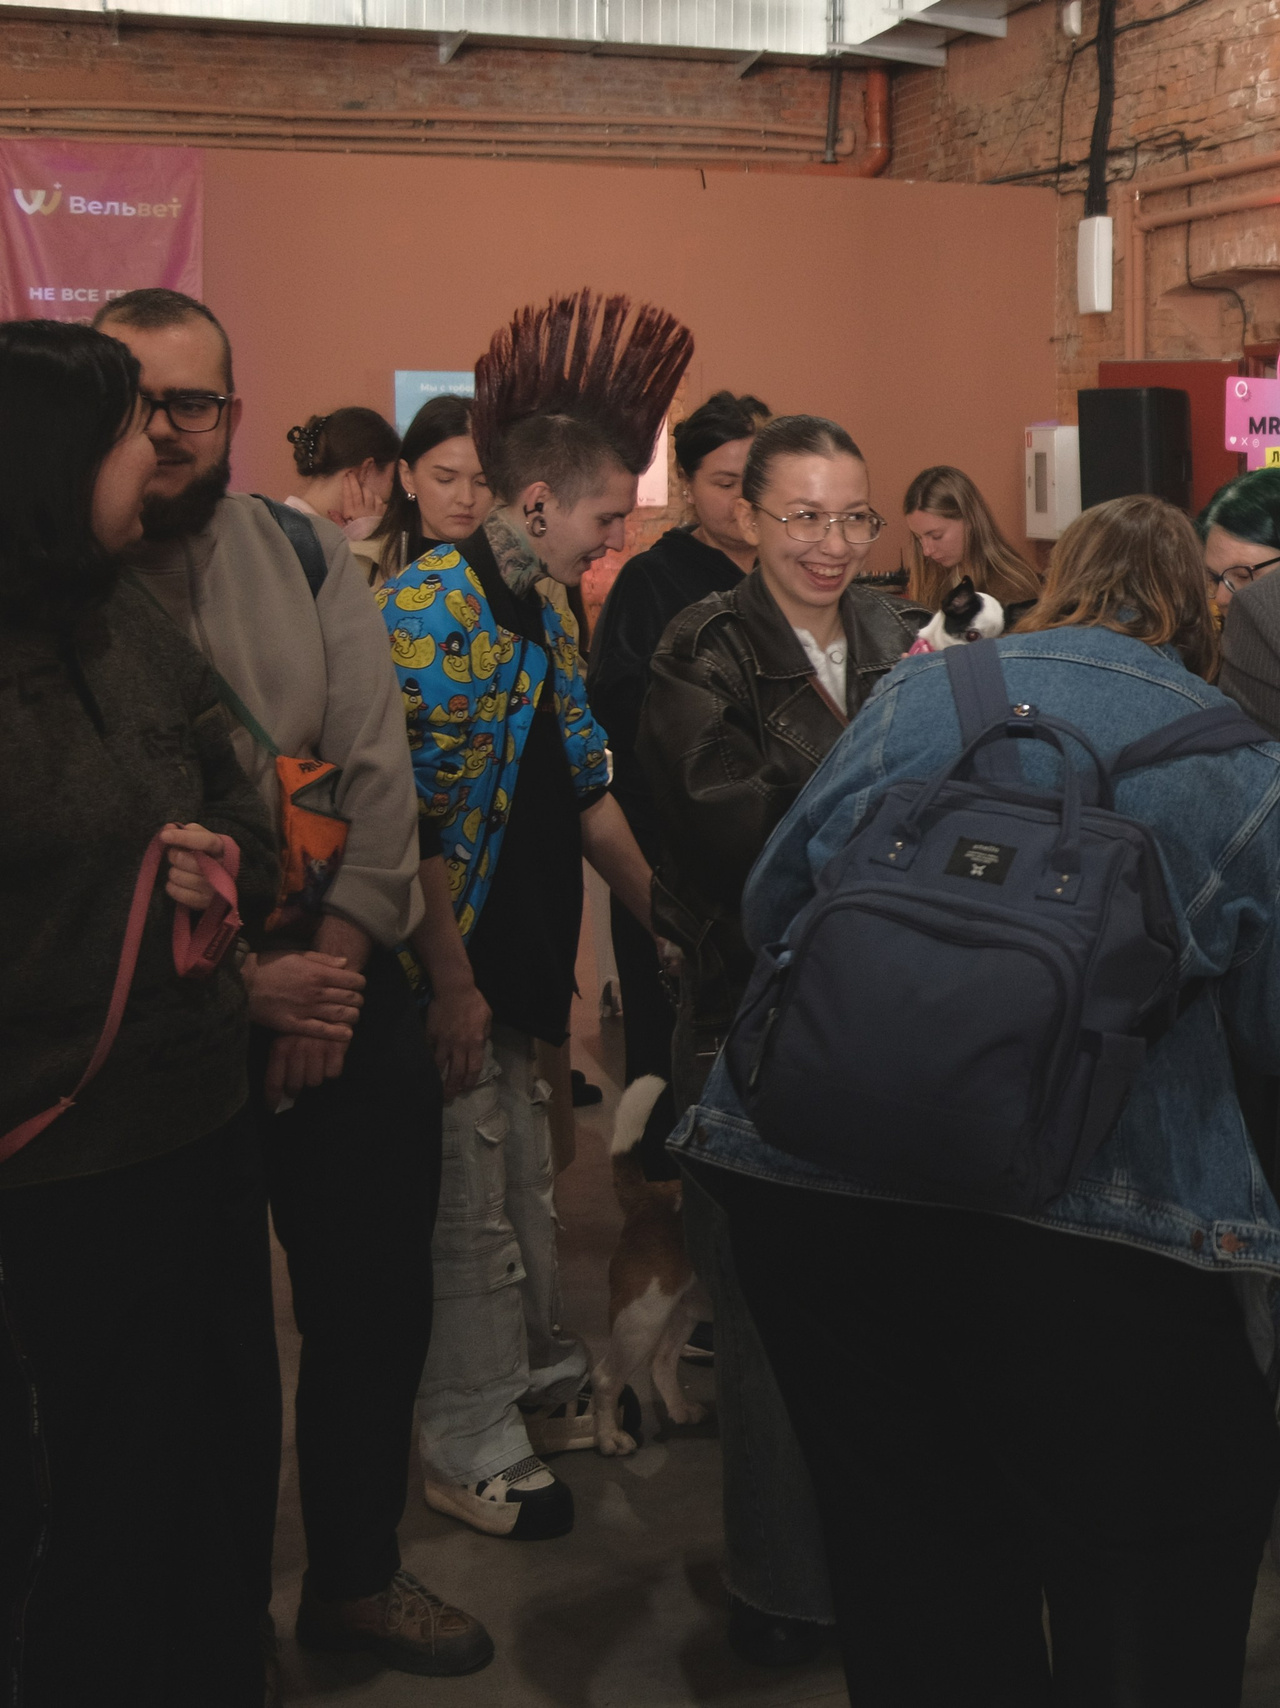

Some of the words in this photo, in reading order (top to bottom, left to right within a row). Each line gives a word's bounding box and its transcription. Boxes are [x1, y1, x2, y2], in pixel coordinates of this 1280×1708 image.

[69, 196, 182, 218] Вельвет
[29, 287, 55, 301] НЕ
[62, 288, 99, 301] ВСЕ
